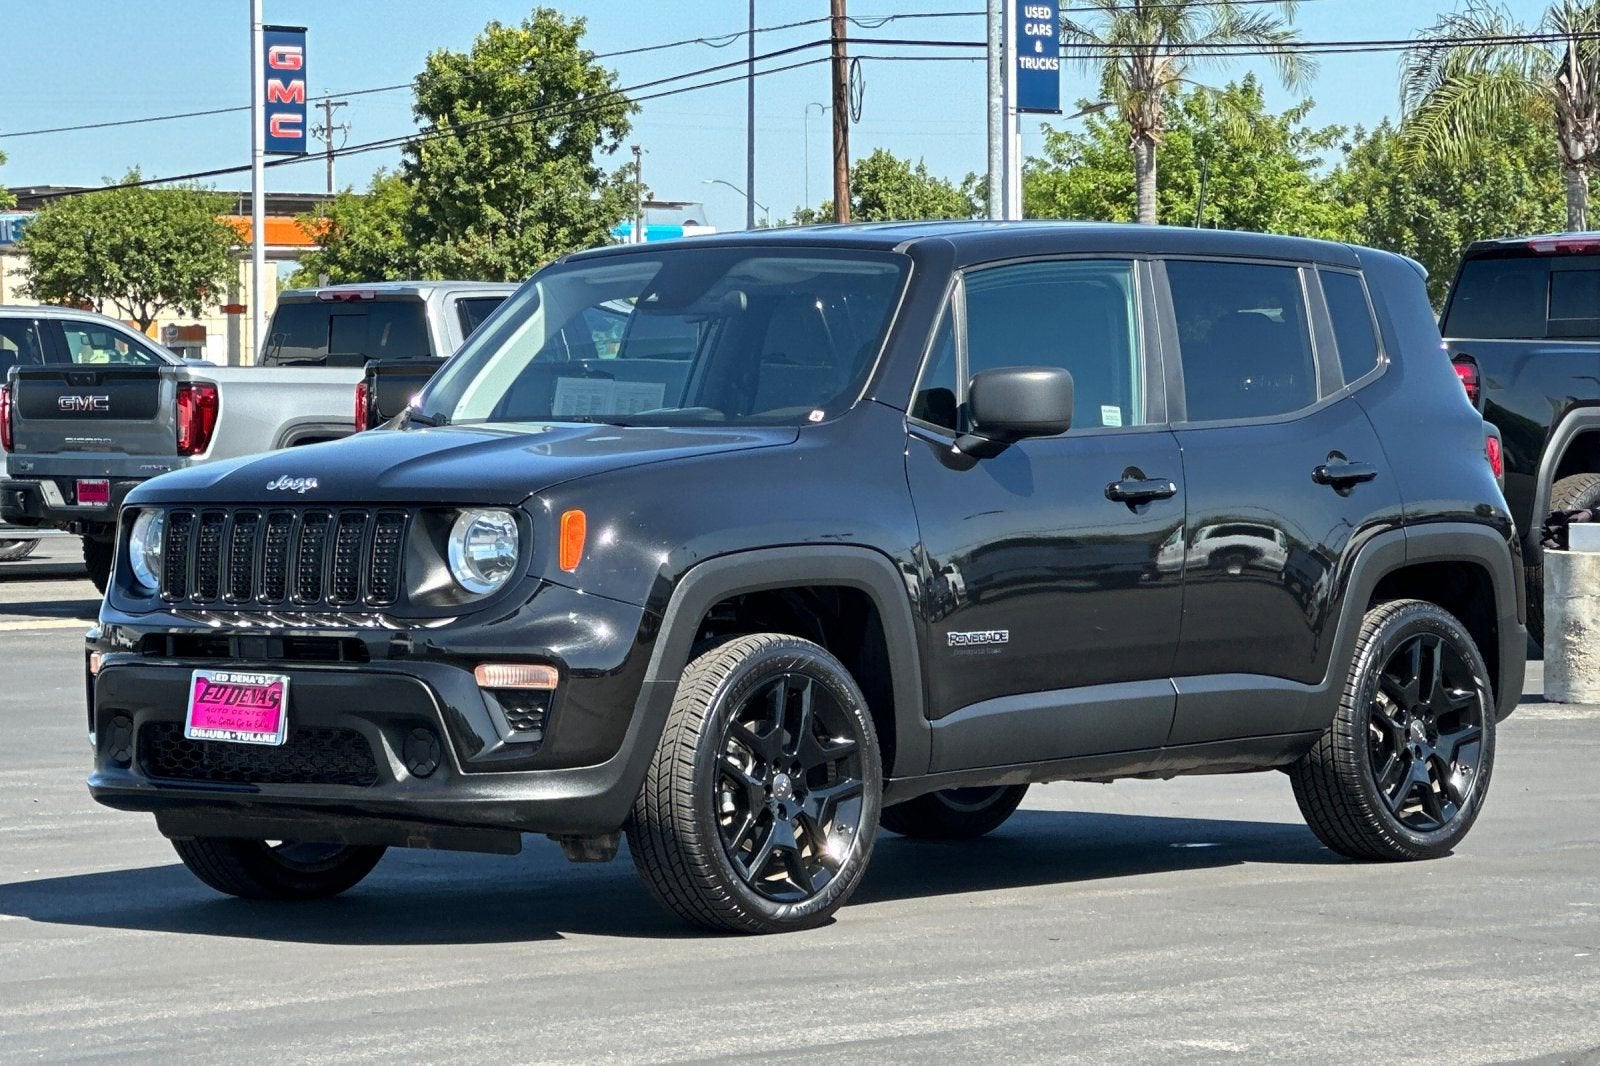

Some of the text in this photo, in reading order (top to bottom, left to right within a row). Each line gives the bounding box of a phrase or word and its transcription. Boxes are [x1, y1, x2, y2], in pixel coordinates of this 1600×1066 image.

[1024, 5, 1052, 19] USED
[1024, 23, 1053, 37] CARS
[1034, 40, 1043, 53] &
[1018, 56, 1059, 71] TRUCKS
[267, 45, 305, 138] GMC
[58, 394, 109, 411] GMC
[266, 474, 318, 494] Jeep
[946, 629, 1009, 647] RENEGADE
